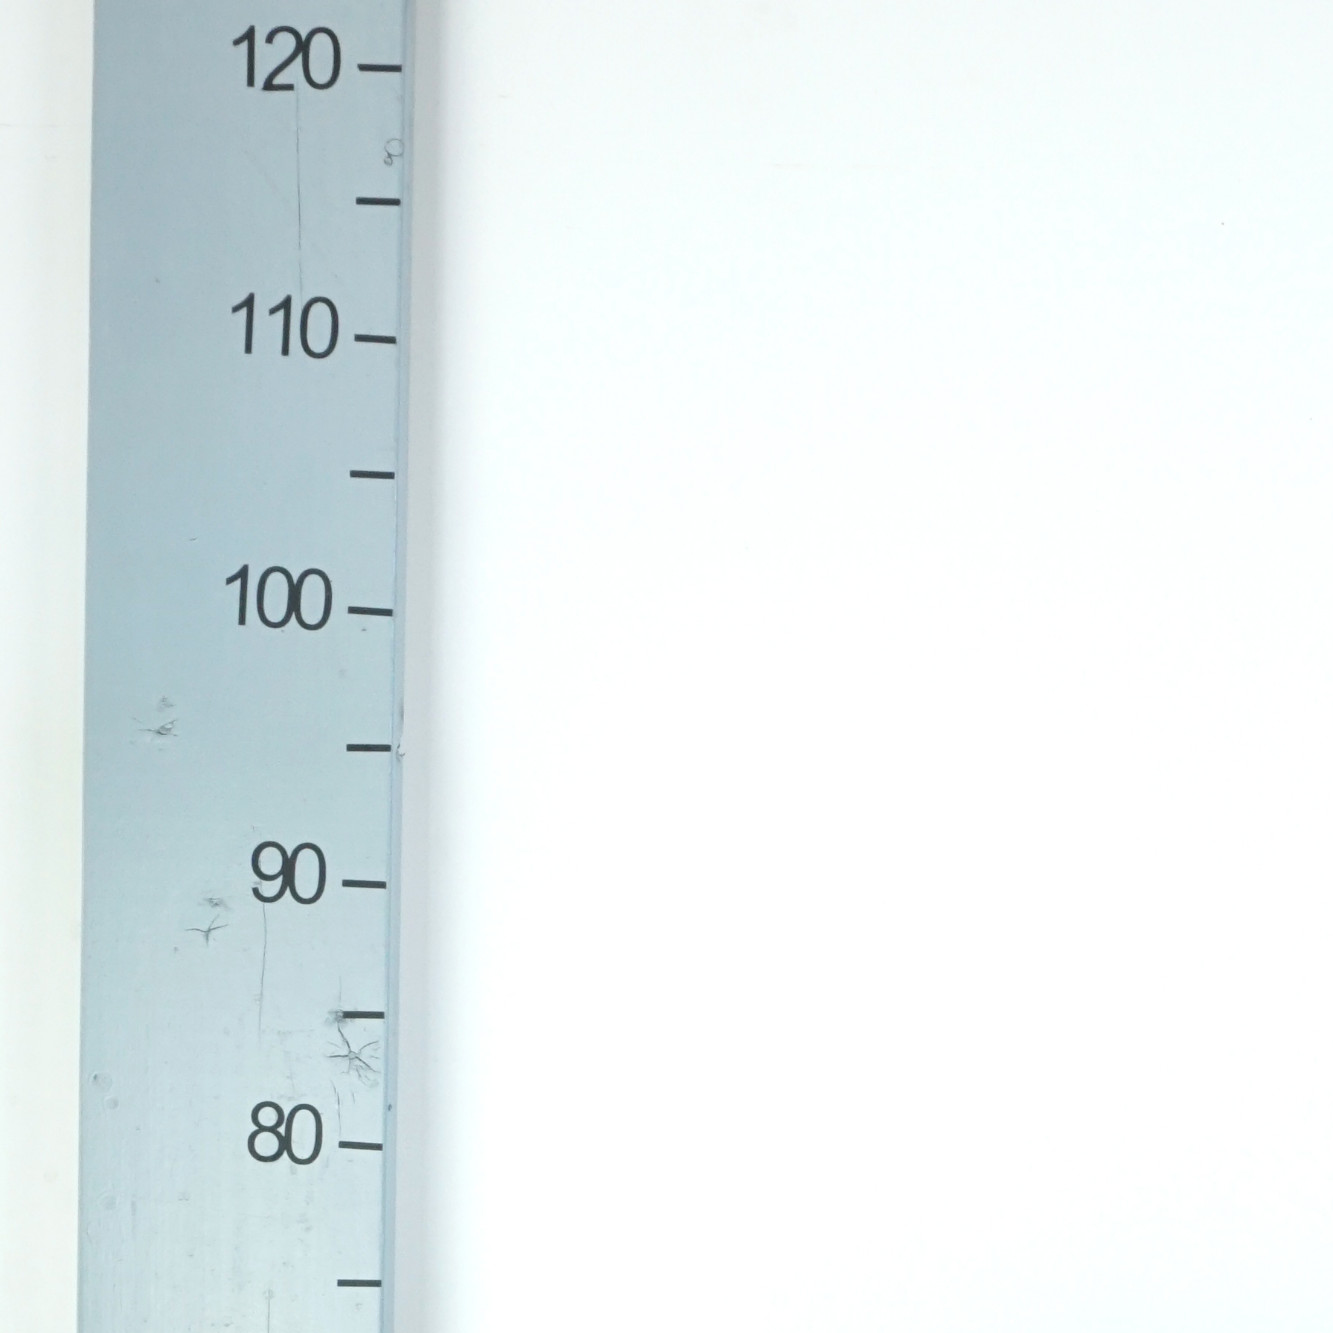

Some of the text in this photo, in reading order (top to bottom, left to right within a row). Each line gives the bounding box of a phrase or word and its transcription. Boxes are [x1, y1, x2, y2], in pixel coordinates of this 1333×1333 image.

[233, 25, 342, 91] 120
[231, 292, 340, 359] 110
[225, 563, 333, 630] 100
[251, 841, 327, 904] 90
[247, 1101, 323, 1165] 80
